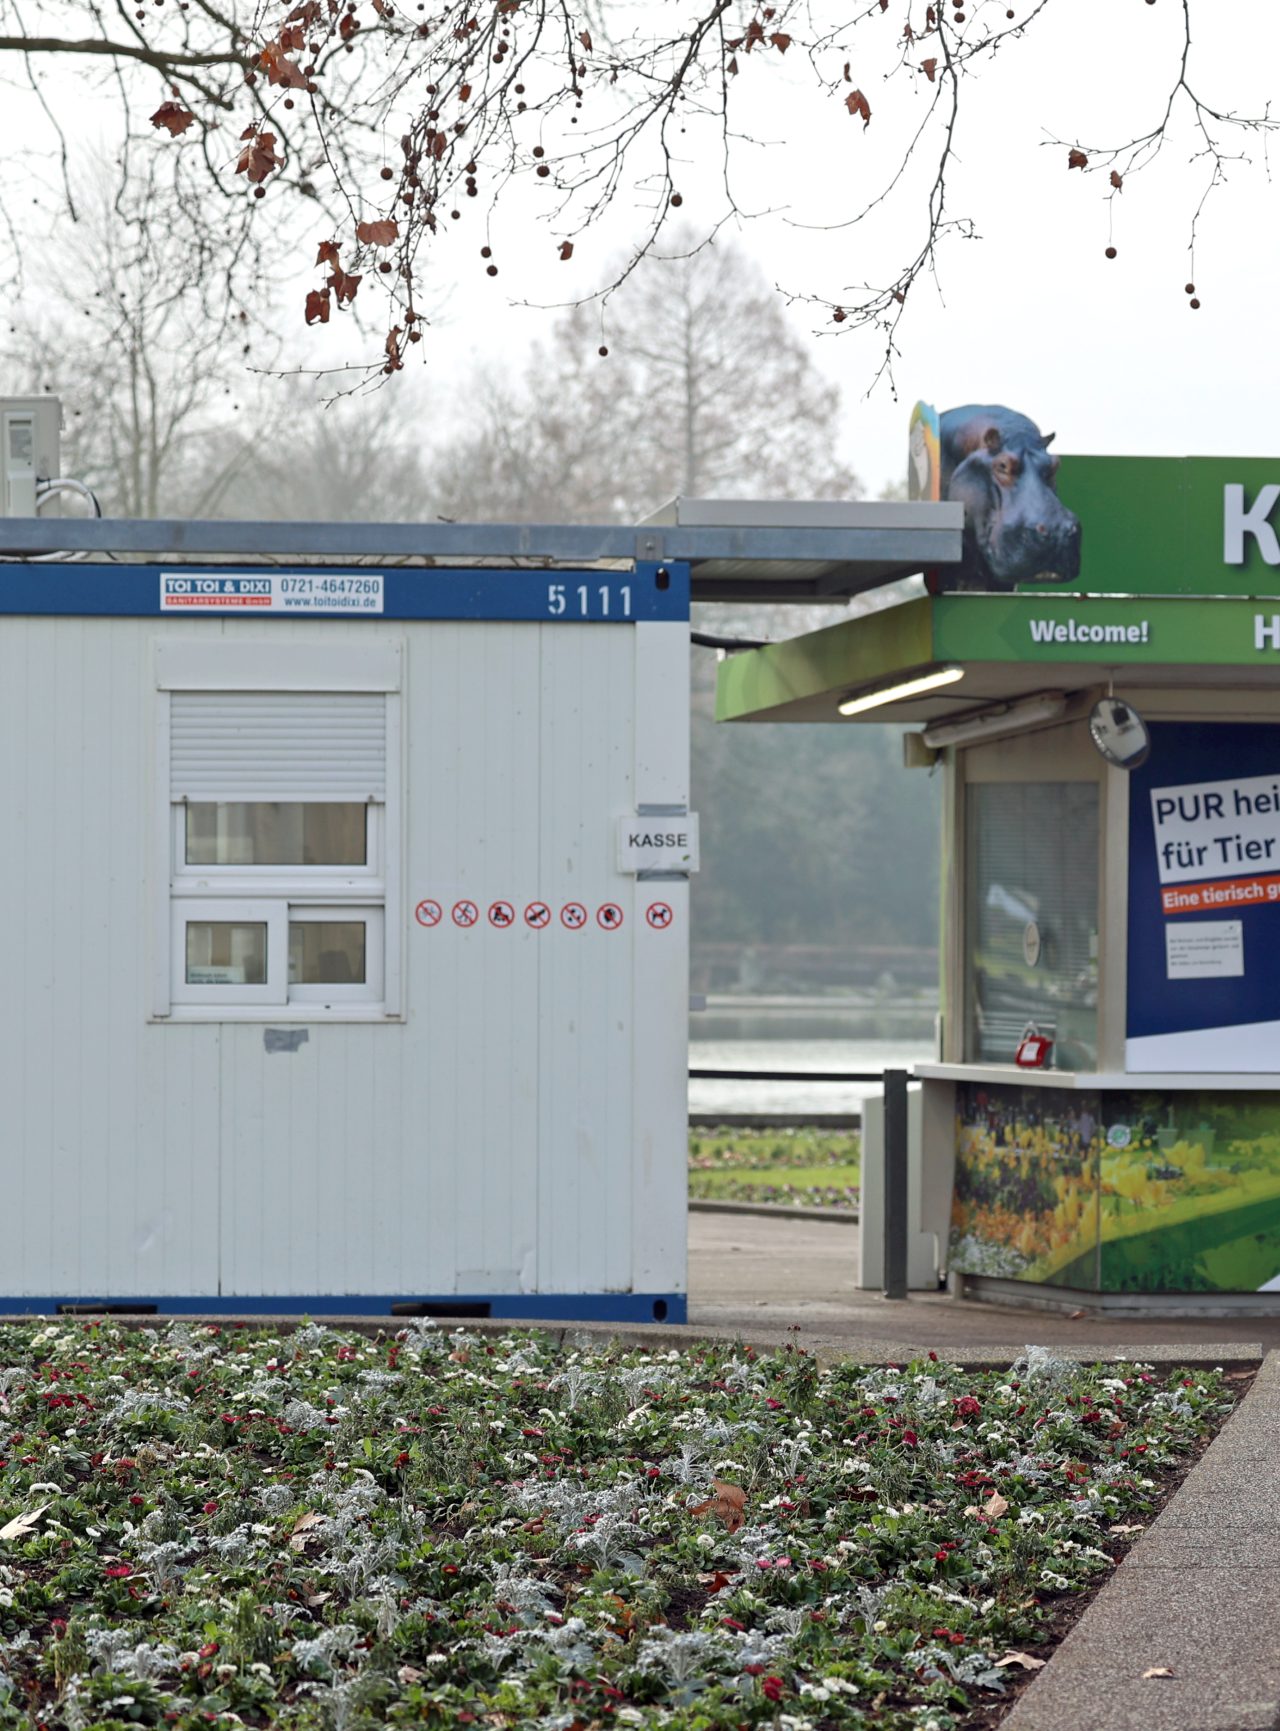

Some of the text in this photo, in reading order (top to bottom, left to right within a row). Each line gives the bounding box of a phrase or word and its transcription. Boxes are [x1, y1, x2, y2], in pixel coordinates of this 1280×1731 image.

[167, 580, 270, 593] TOI TOI & DIXI
[281, 578, 379, 593] 0721-4647260
[284, 596, 377, 607] www.toitoidixi.de
[548, 584, 631, 616] 5111
[1029, 619, 1149, 643] Welcome!
[1155, 793, 1225, 825] PUR
[628, 833, 688, 848] KASSE
[1161, 841, 1208, 870] für
[1213, 834, 1277, 865] Tier
[1163, 890, 1200, 909] Eine
[1202, 882, 1264, 905] tierisch
